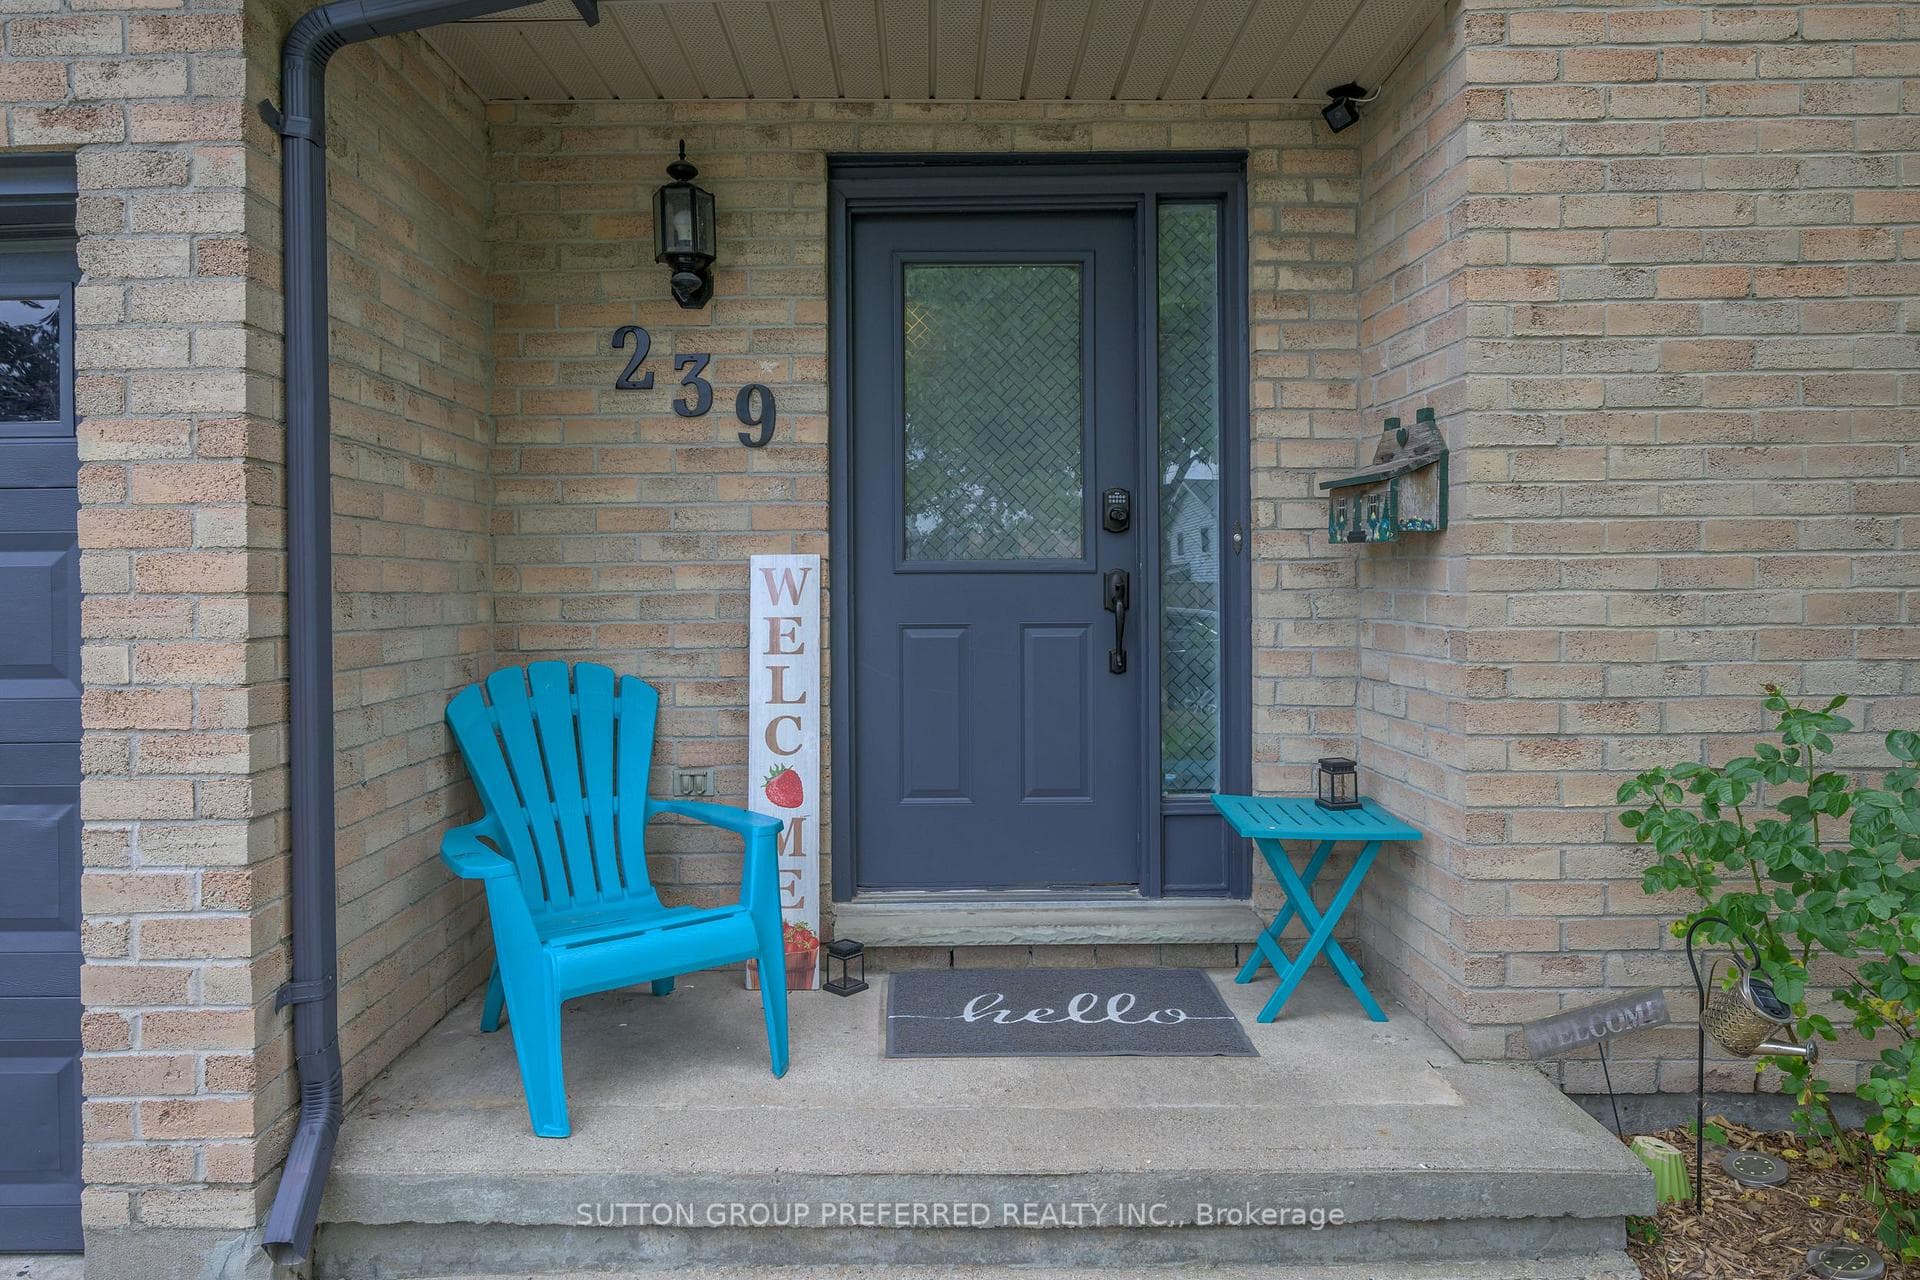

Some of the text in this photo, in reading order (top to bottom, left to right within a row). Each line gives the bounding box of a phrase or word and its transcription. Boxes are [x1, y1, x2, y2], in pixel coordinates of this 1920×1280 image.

[612, 326, 775, 447] 239
[759, 567, 812, 909] WELCME
[956, 992, 1192, 1024] hello
